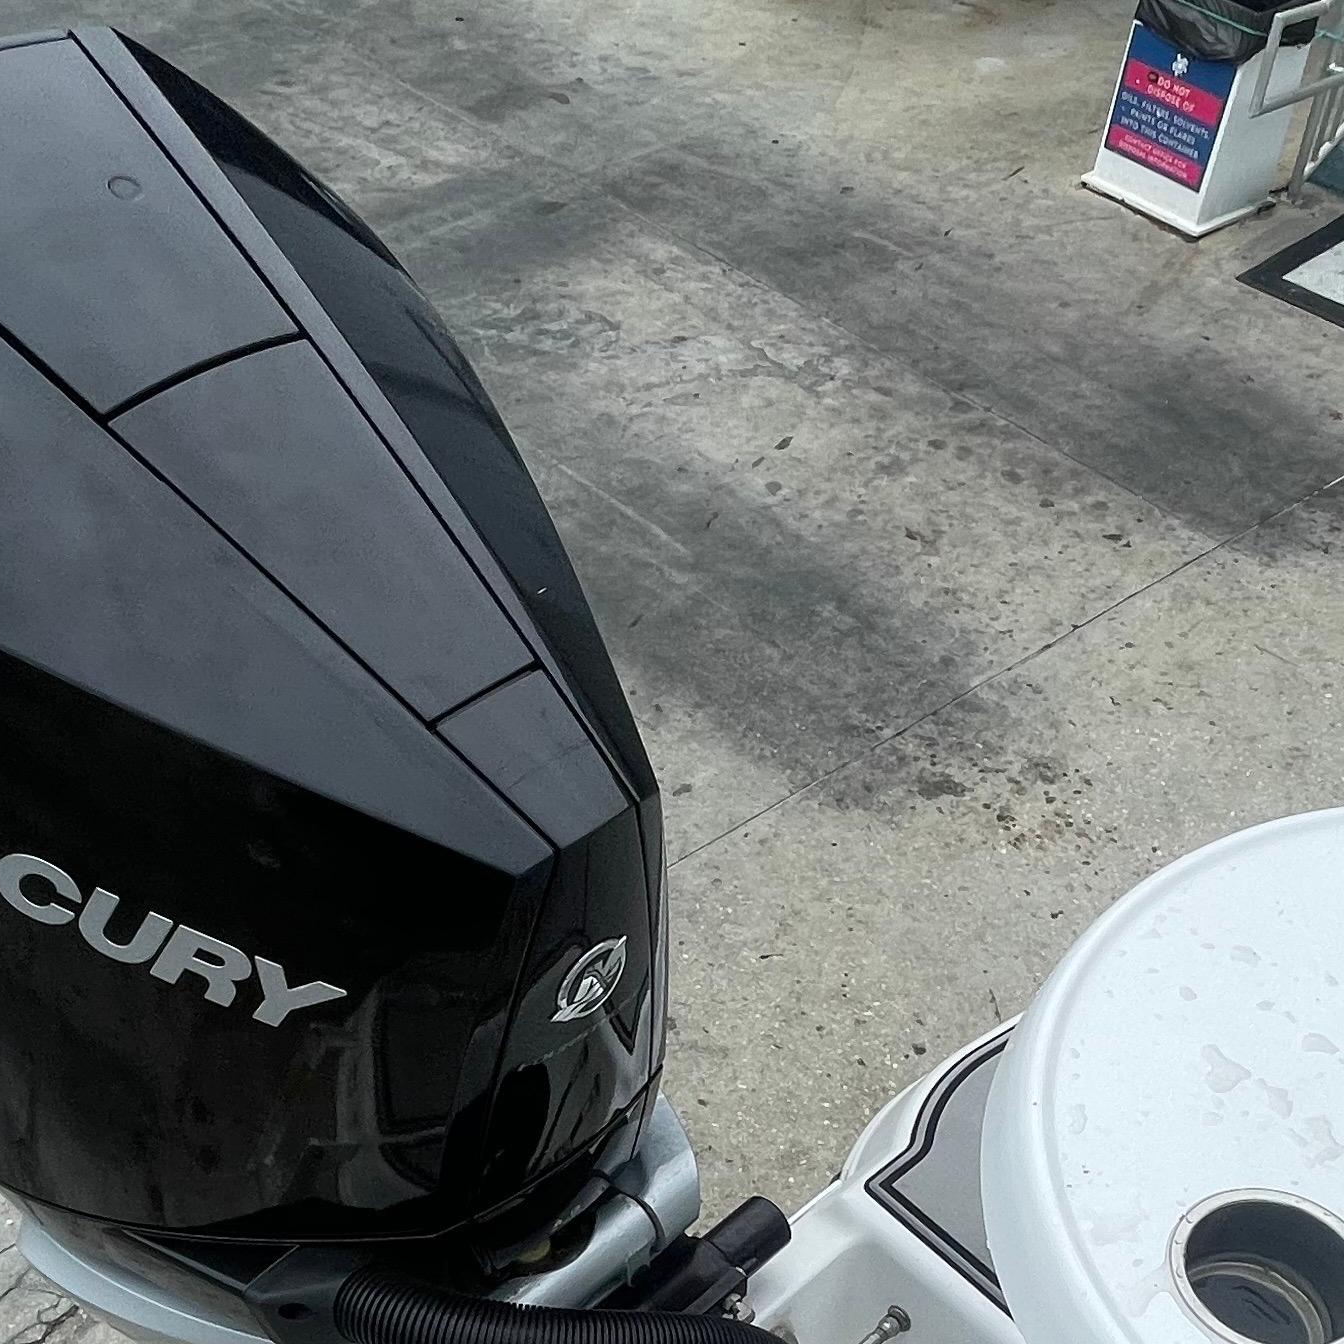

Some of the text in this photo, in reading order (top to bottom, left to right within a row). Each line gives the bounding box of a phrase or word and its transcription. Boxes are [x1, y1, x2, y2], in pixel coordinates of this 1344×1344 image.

[1147, 84, 1195, 112] DISPOSE OF
[1158, 76, 1190, 98] DO NOT
